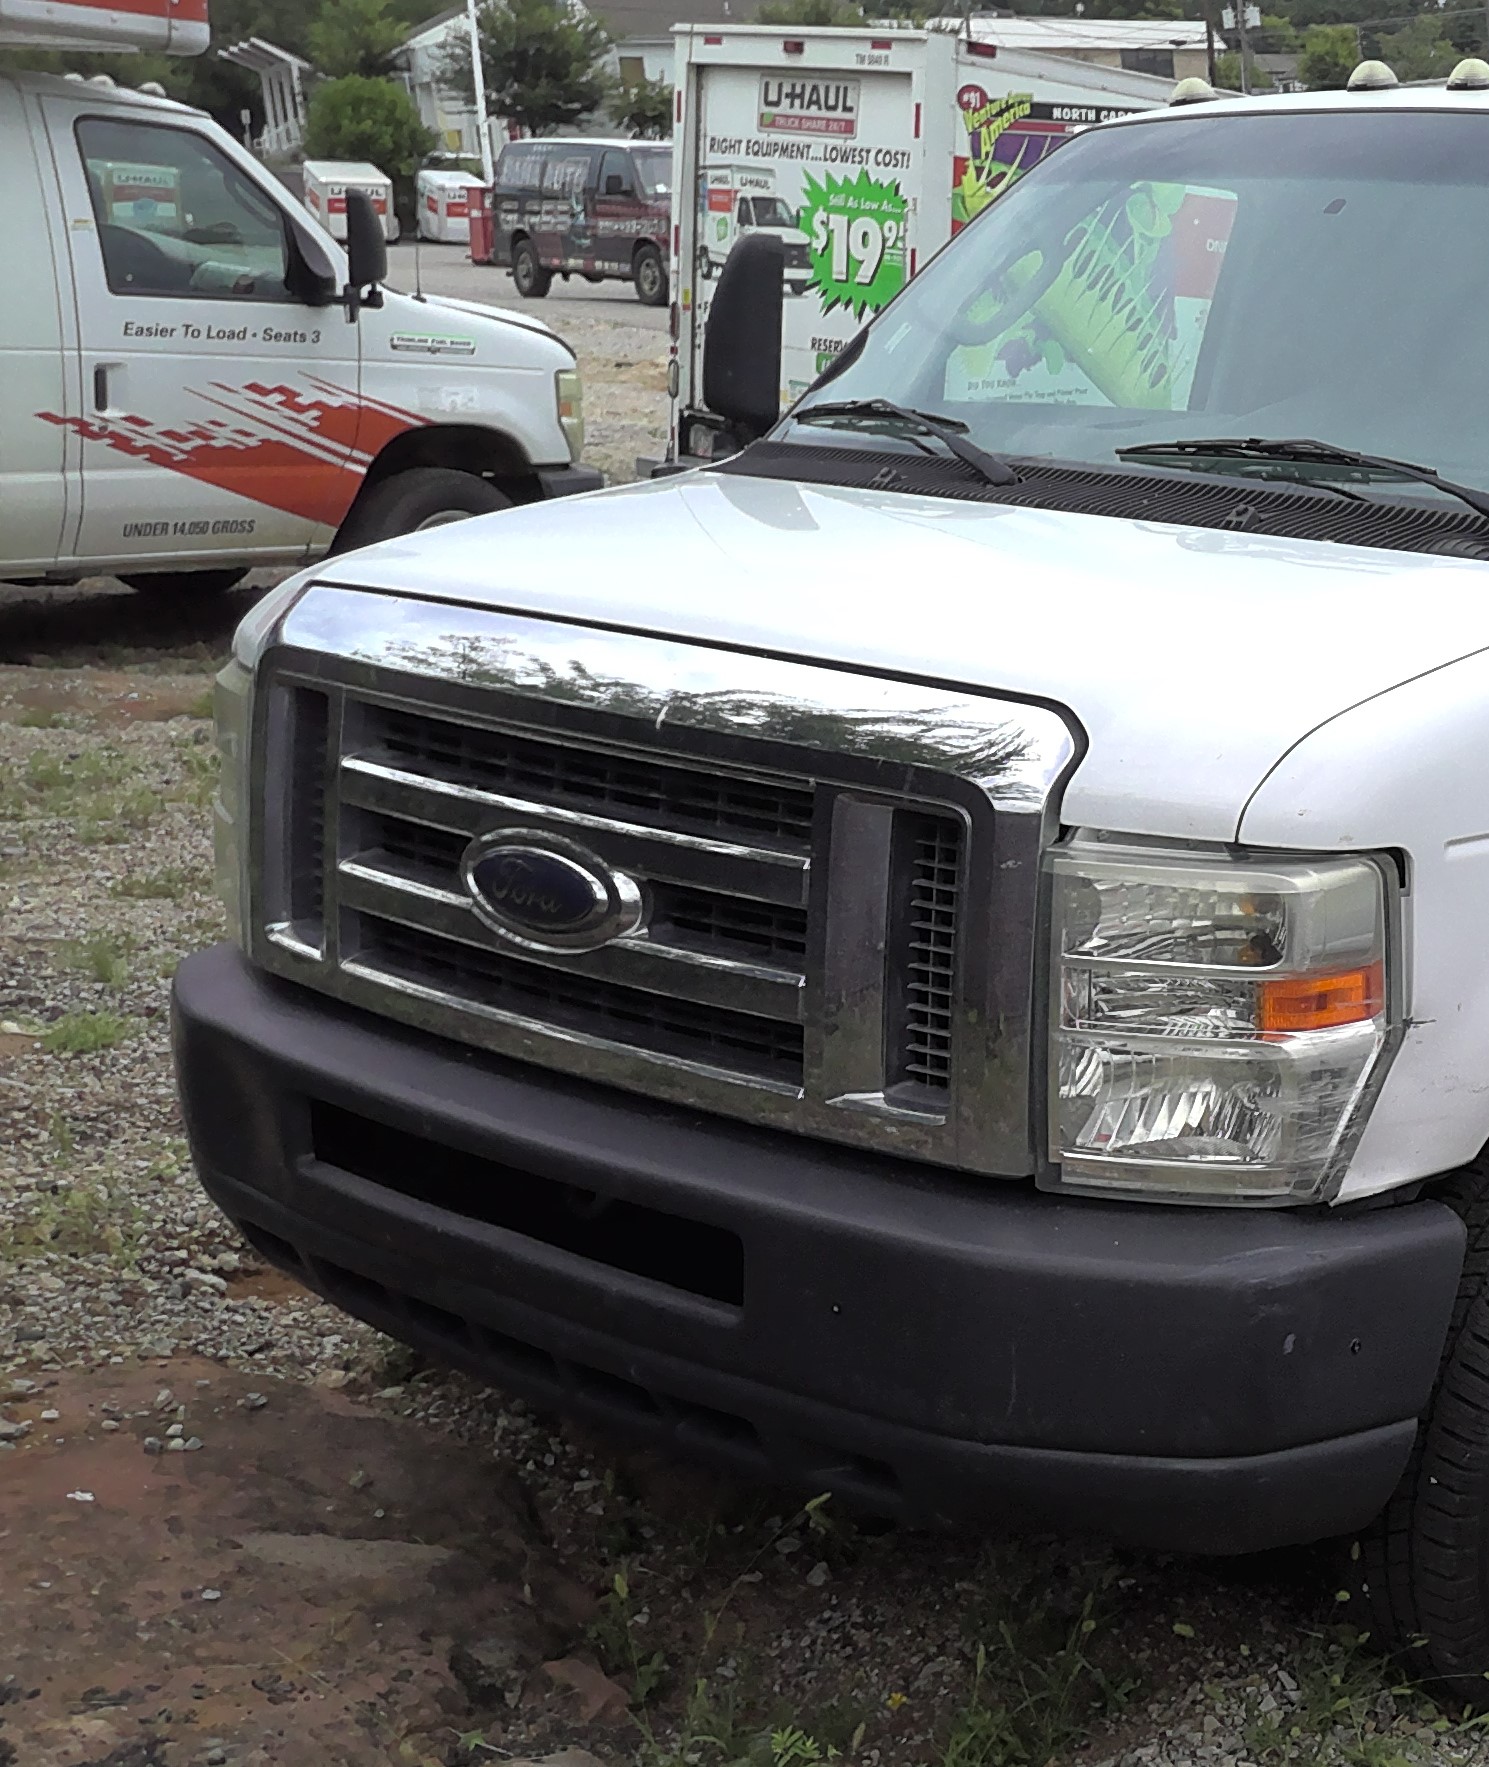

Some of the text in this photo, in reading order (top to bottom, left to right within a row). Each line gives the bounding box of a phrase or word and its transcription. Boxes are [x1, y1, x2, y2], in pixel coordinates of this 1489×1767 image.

[763, 81, 854, 113] U-HAUL
[962, 91, 980, 109] #91
[963, 99, 1007, 136] Venture
[1052, 106, 1096, 121] NORTH
[980, 102, 1030, 163] America
[709, 136, 742, 156] RIGHT
[874, 149, 911, 169] COST!
[860, 197, 880, 210] Low
[123, 321, 321, 344] Easier To Load Seats 3
[122, 522, 170, 538] UNDER
[212, 519, 256, 535] GROSS
